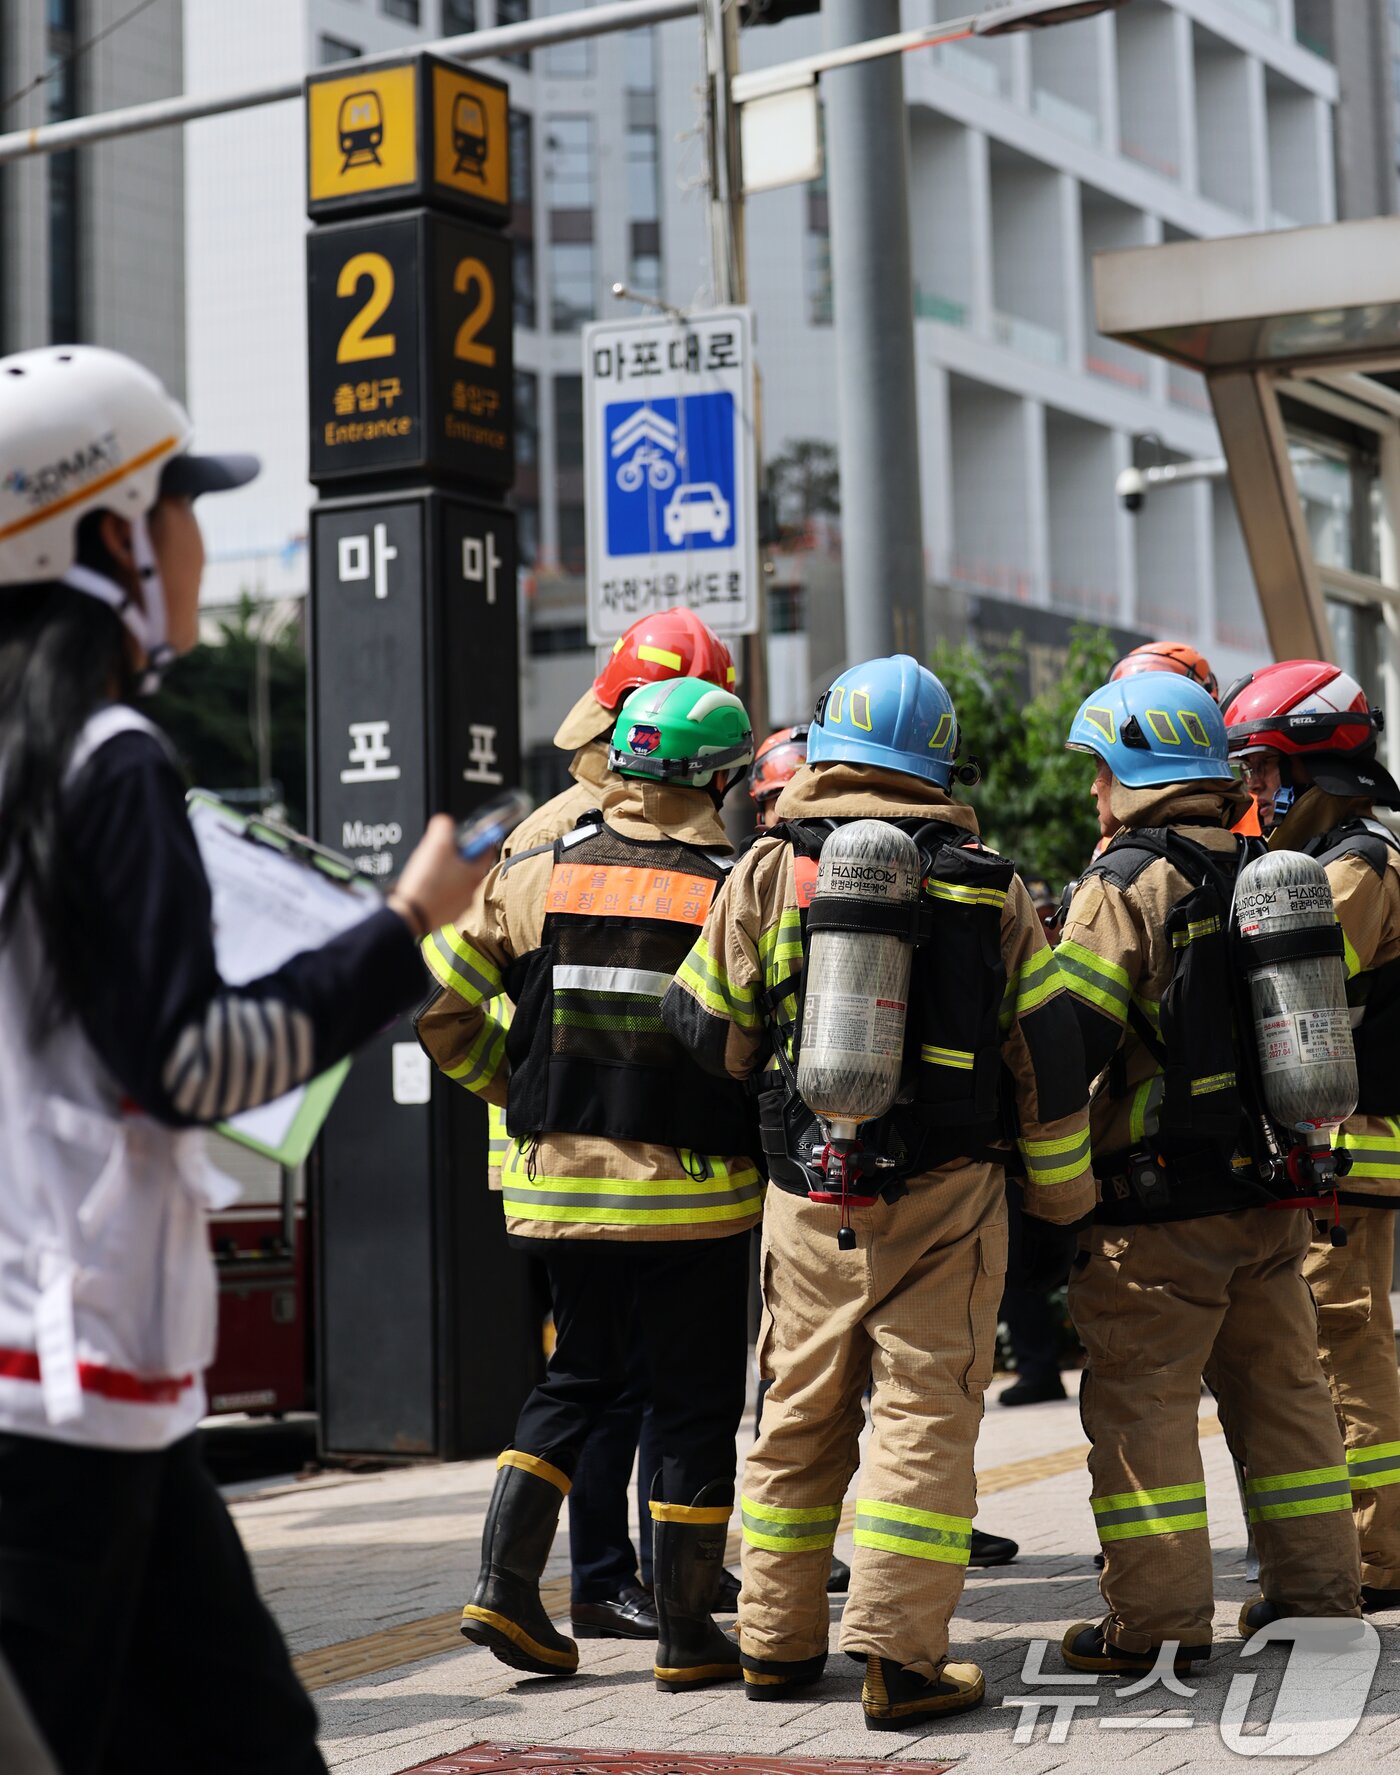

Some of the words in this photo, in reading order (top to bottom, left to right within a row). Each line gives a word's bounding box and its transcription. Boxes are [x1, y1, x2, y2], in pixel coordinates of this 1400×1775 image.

[336, 252, 396, 365] 2
[452, 257, 496, 368] 2
[593, 332, 741, 383] 마포대로
[333, 377, 403, 415] 출입구
[325, 416, 412, 446] Entrance
[445, 414, 506, 448] Entrance
[1290, 717, 1316, 727] PETZL
[343, 820, 402, 852] Mapo
[830, 880, 888, 895] 한컴라이프케어
[831, 865, 897, 883] HANCOM
[1288, 886, 1331, 900] HANCO
[1269, 1048, 1291, 1058] 2027.04
